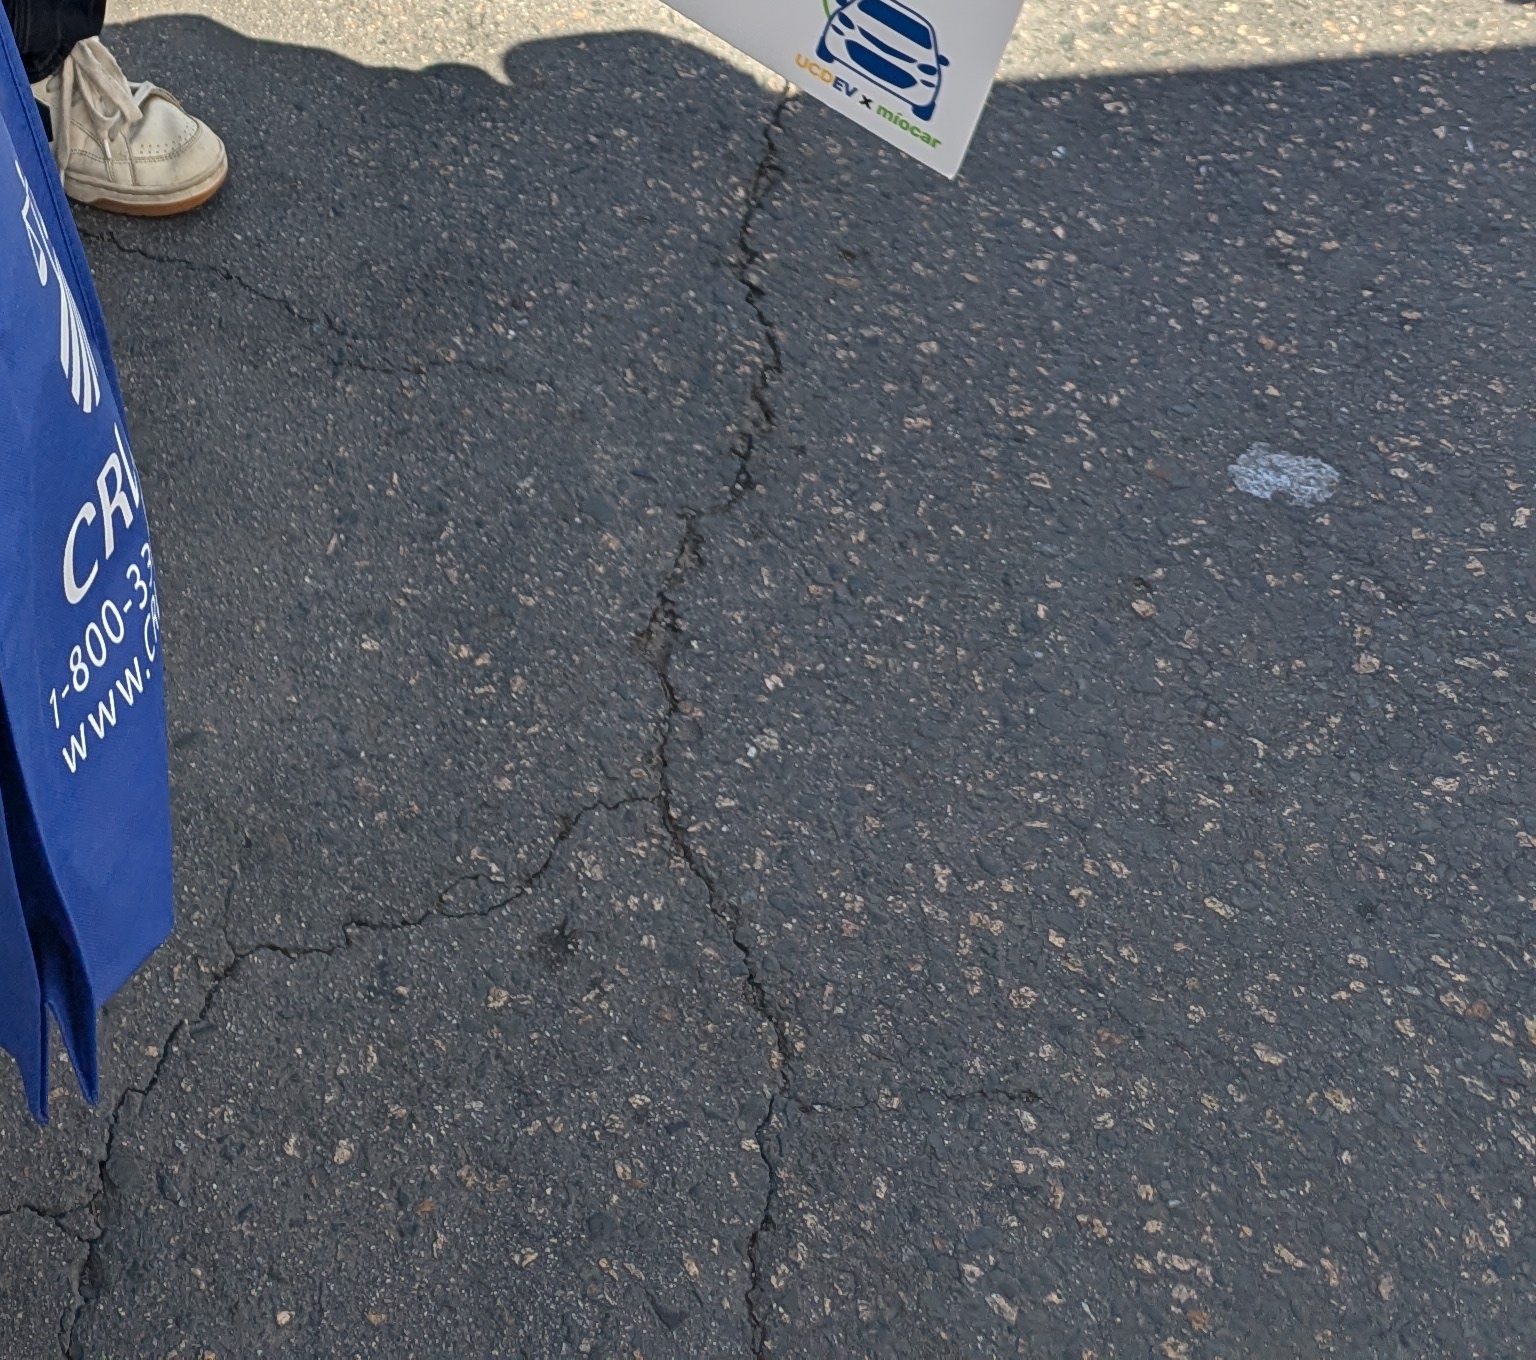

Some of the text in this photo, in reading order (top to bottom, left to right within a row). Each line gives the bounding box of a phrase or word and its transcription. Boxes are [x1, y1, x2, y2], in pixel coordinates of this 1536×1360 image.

[795, 53, 858, 97] UCDEV
[859, 94, 873, 110] x
[49, 542, 154, 729] 1-800-33
